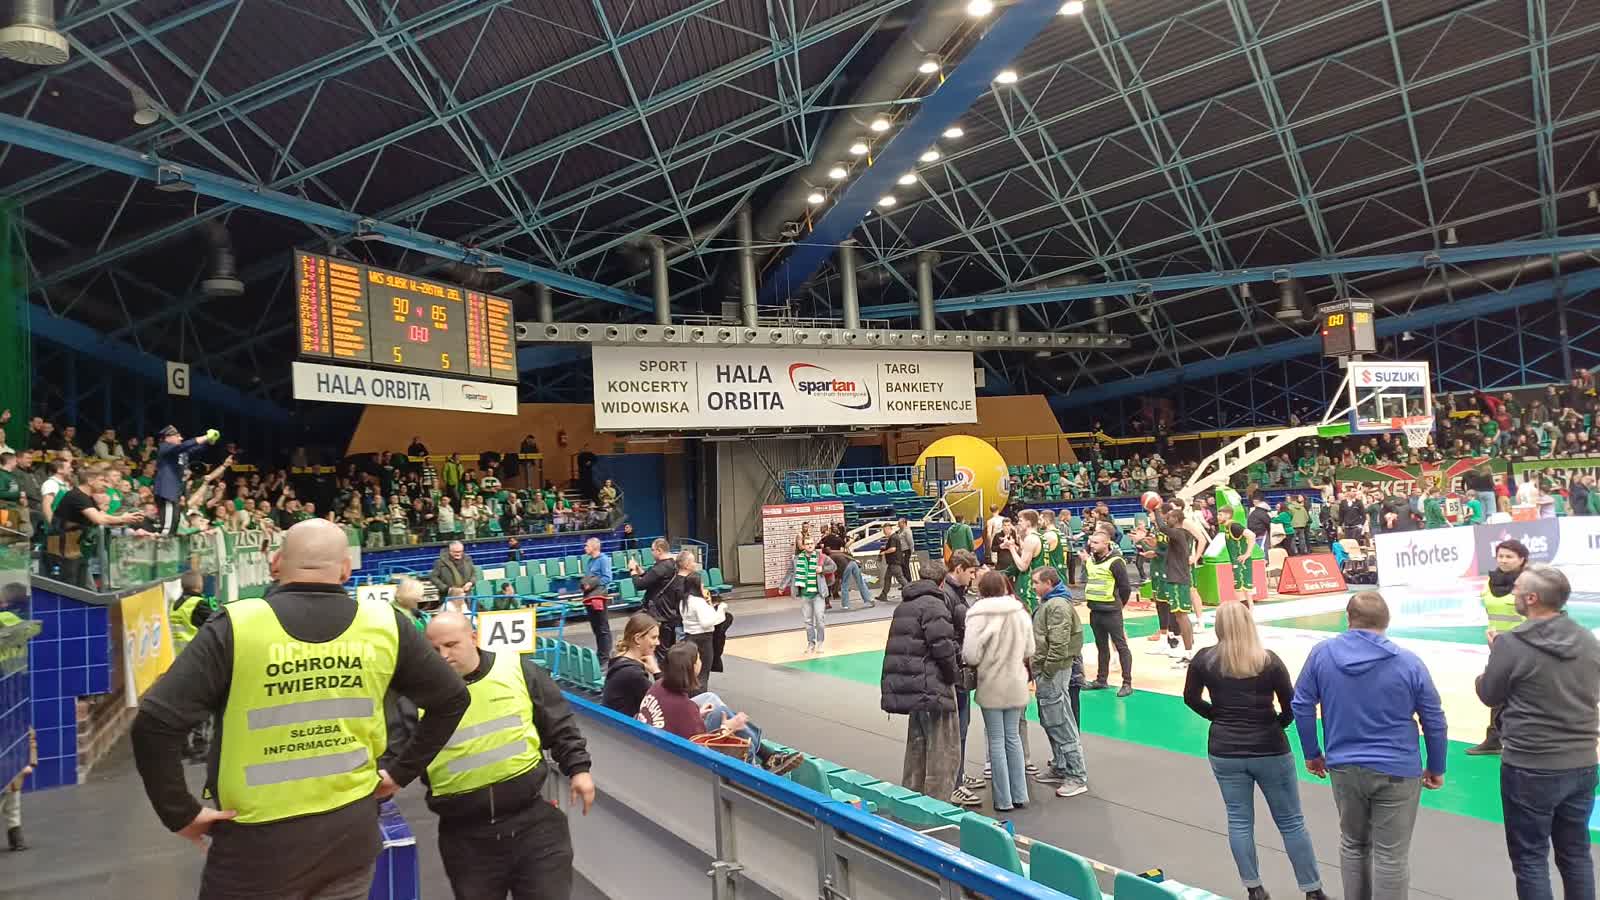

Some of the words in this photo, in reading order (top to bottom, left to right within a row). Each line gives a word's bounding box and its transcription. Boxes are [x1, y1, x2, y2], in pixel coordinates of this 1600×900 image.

[393, 297, 409, 315] 90
[431, 305, 447, 322] 85
[393, 346, 402, 363] 5
[442, 353, 451, 369] 5
[639, 360, 688, 372] SPORT
[716, 364, 773, 384] HALA
[884, 363, 920, 374] TARGI
[172, 368, 185, 390] G
[1374, 371, 1420, 383] SUZUKI
[316, 372, 367, 396] HALA
[371, 377, 431, 402] ORBITA
[608, 380, 689, 393] KONCERTY
[798, 378, 856, 396] spartan
[886, 382, 944, 393] BANKIETY
[601, 401, 690, 414] WIDOWISKA
[707, 391, 785, 411] ORBITA
[887, 400, 973, 411] KONFERENCJE
[1396, 543, 1459, 569] infortes
[488, 619, 526, 646] A5
[266, 655, 363, 678] OCHRONA
[264, 675, 364, 697] TWIERDZA
[290, 724, 342, 738] SŁUŻBA
